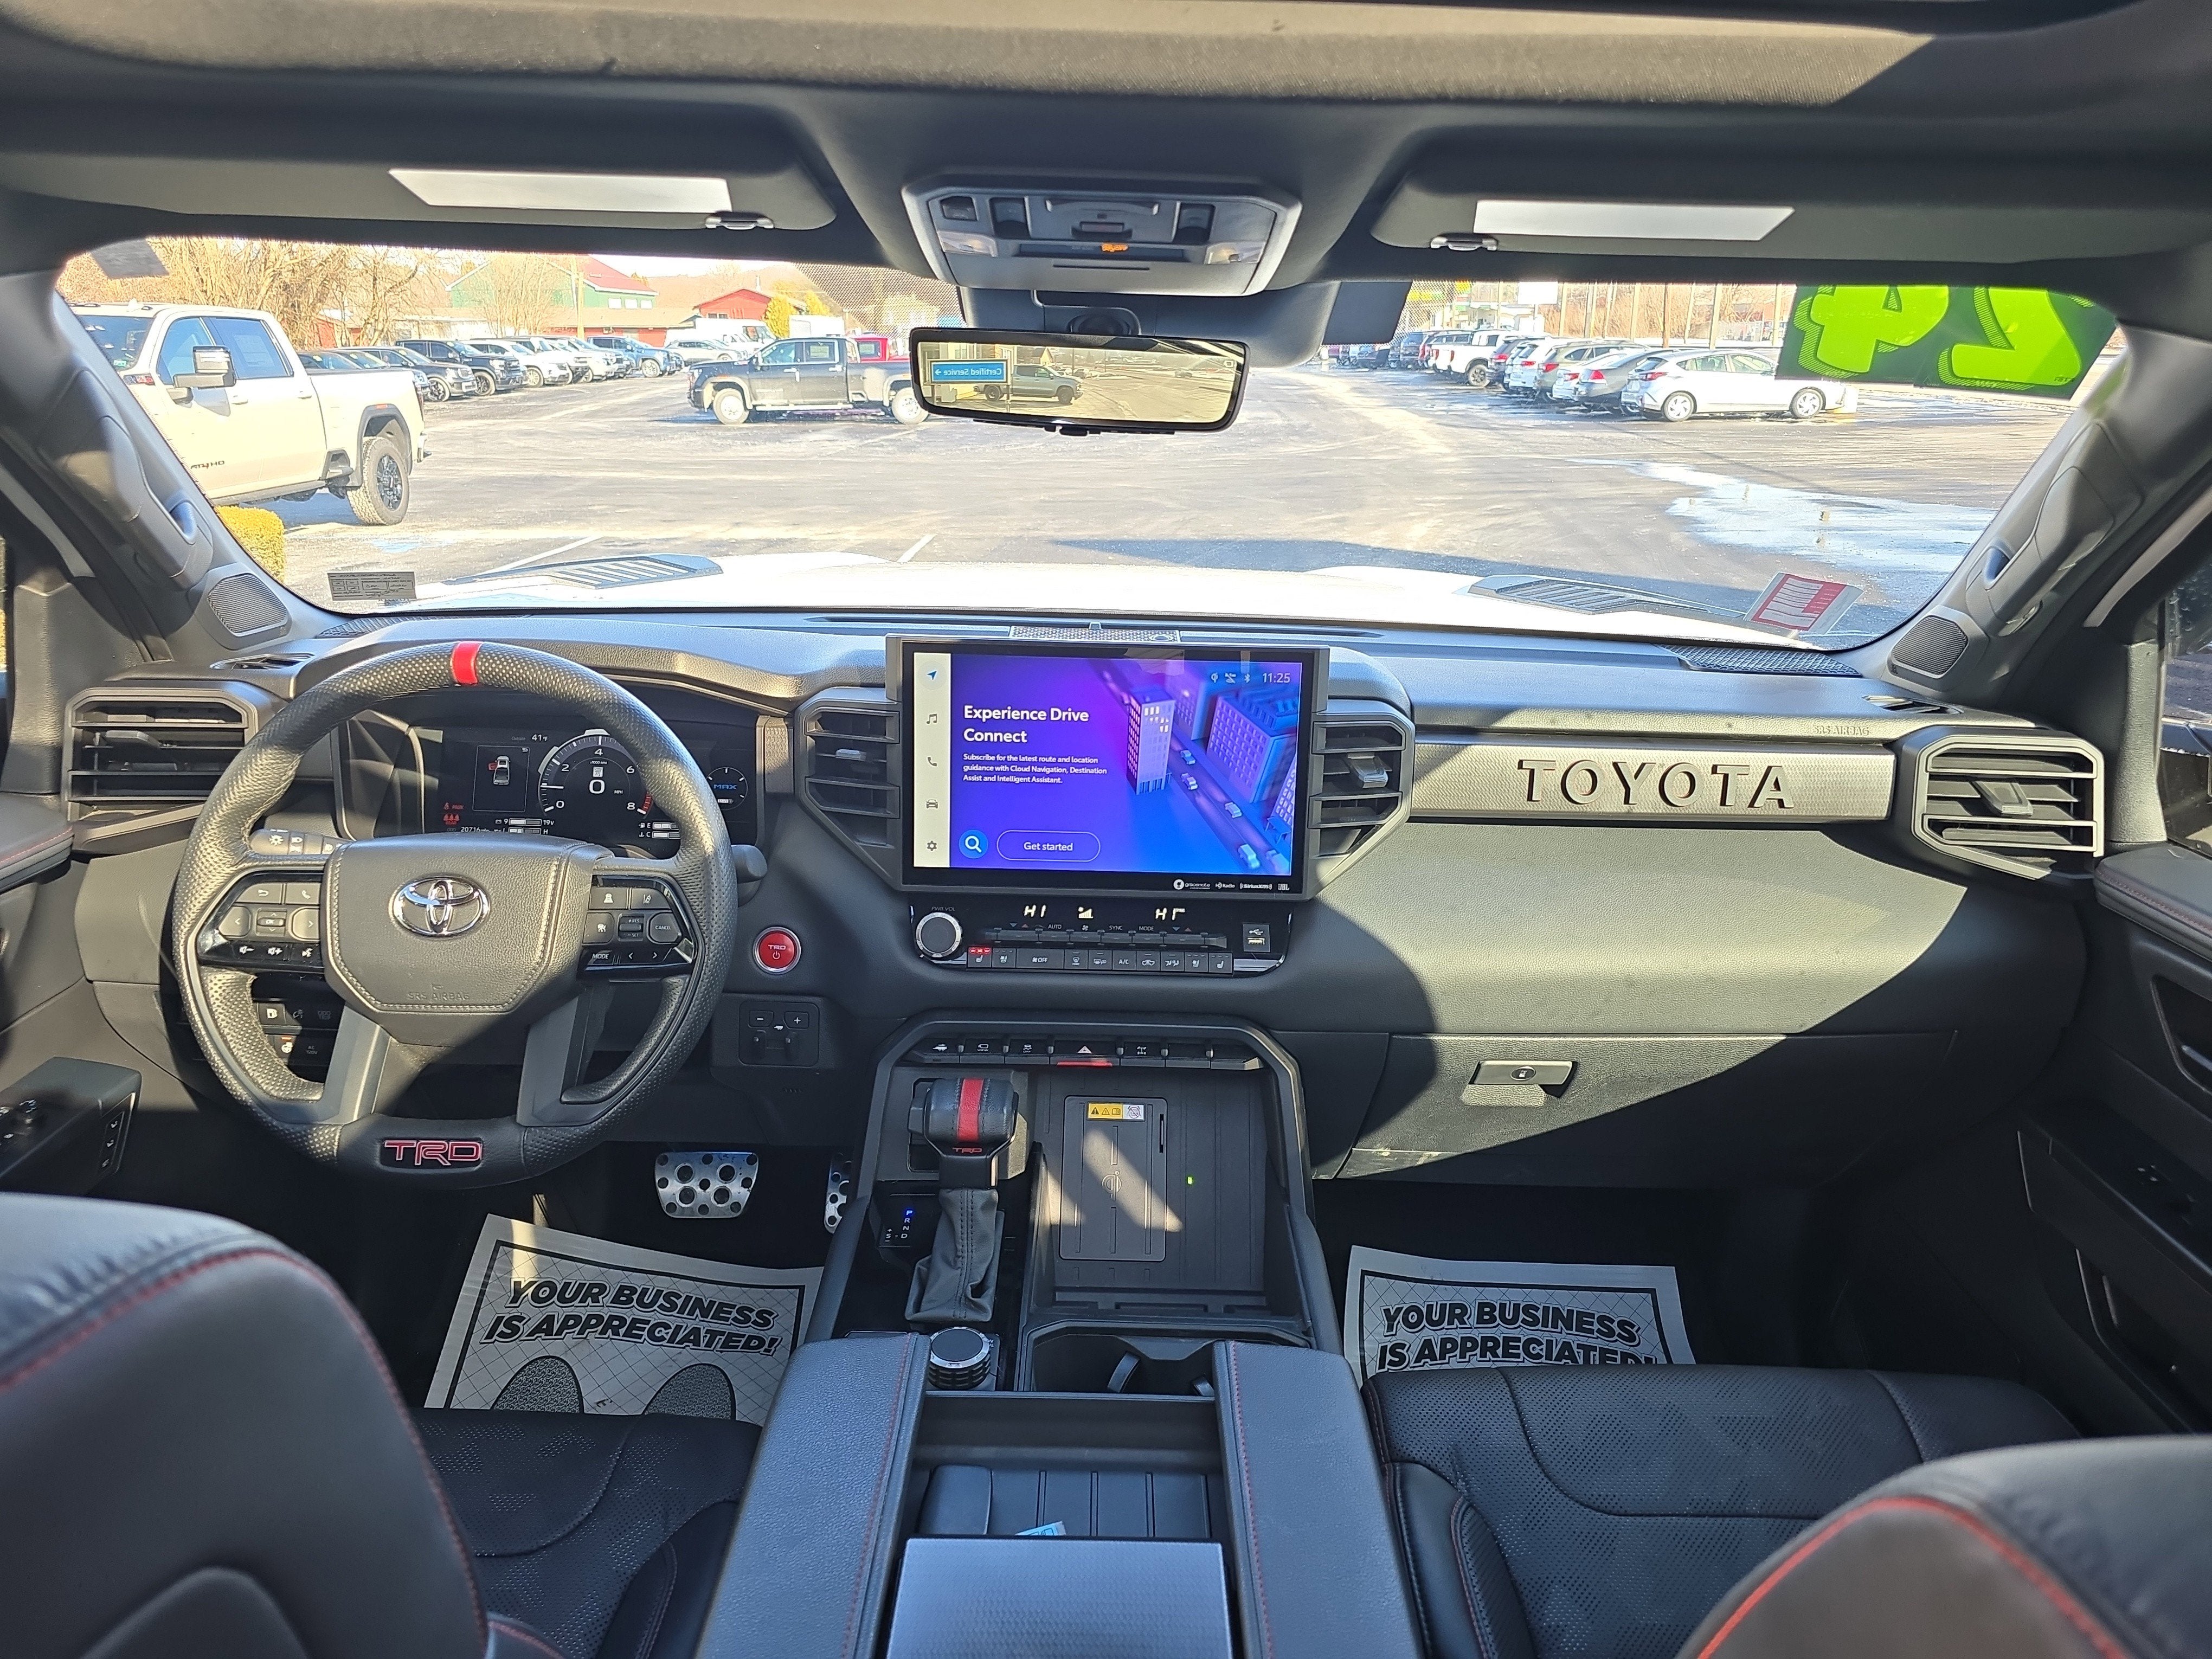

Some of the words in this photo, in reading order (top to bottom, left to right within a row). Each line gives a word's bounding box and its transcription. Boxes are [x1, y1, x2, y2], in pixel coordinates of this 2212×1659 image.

[1262, 672, 1290, 683] 11:25
[964, 705, 1047, 722] Experience
[1050, 707, 1089, 722] Drive
[963, 728, 1028, 743] Connect
[1832, 725, 1869, 736] AIRBAG
[963, 753, 995, 761] Subscribe
[626, 766, 635, 774] 6
[963, 764, 994, 772] guidance
[1031, 766, 1069, 774] Navigation,
[589, 779, 605, 794] 0
[998, 775, 1031, 784] Intelligent
[1518, 759, 1795, 809] TOYOTA
[1024, 841, 1041, 851] Get
[1042, 843, 1073, 851] started
[407, 992, 427, 1000] SRS
[433, 992, 470, 1000] AIRBAG
[383, 1140, 483, 1166] TRD
[506, 1278, 608, 1307] YOUR
[610, 1283, 780, 1329] BUSINESS
[1382, 1302, 1471, 1336] YOUR
[1474, 1301, 1640, 1346] BUSINESS
[481, 1313, 529, 1343] IS
[527, 1312, 782, 1355] APPRECIATED!
[1377, 1342, 1411, 1372] IS
